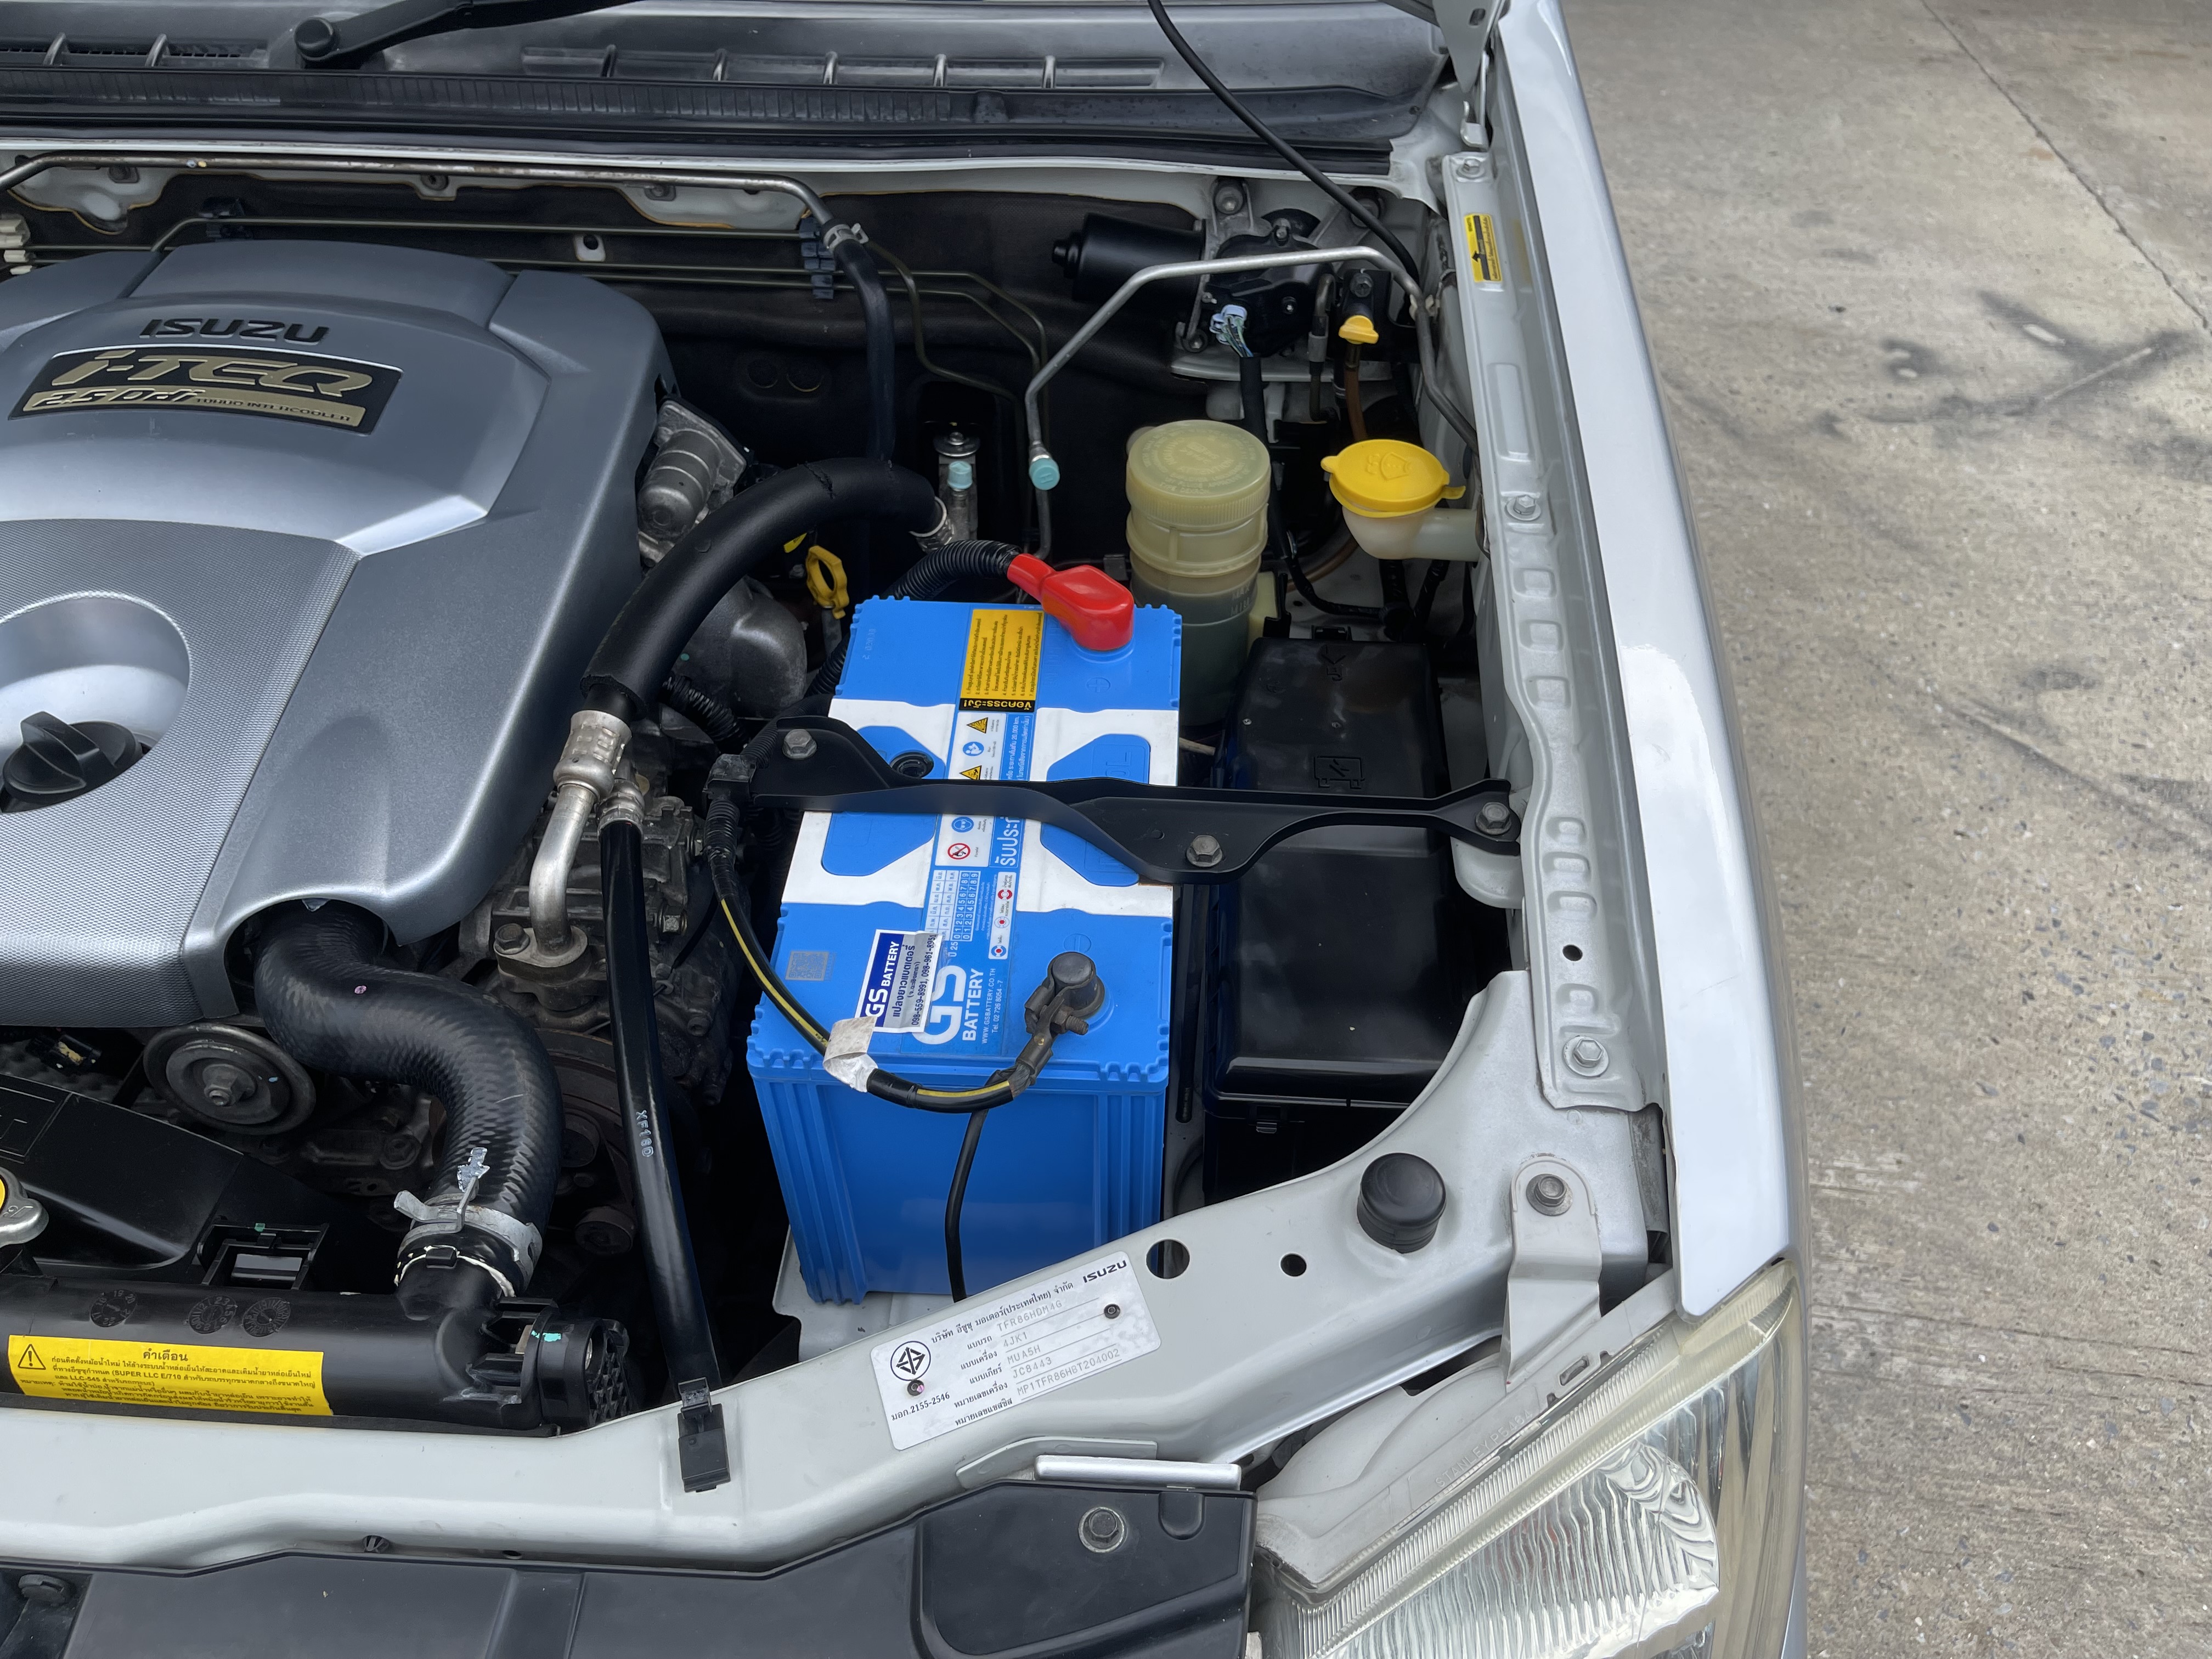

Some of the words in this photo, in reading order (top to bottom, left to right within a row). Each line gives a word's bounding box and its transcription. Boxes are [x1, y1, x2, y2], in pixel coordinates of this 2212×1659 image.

[139, 319, 329, 343] ISUZU
[247, 401, 351, 422] INTERCOOLER
[963, 699, 1032, 710] ข้อควรระวัง!
[950, 941, 958, 950] 25
[865, 989, 888, 1018] GS
[881, 941, 900, 986] BATTERY
[891, 945, 915, 1017] แปลงยาวแบตเตอรี่
[911, 979, 929, 1025] 098-559-8991,
[921, 934, 936, 977] 098-961-8951
[911, 965, 967, 1045] GS
[962, 968, 984, 1041] BATTERY
[982, 968, 996, 1044] WWW.GSBATTERY.CO.TH
[993, 1014, 1000, 1022] 02
[931, 1328, 953, 1344] บริษัท
[975, 1289, 1052, 1327] มอเตอร์(ประเทศไทย)
[1053, 1281, 1074, 1295] จำกัด
[1082, 1260, 1127, 1284] ISUZU
[966, 1335, 993, 1351] แบบรถ
[996, 1299, 1063, 1333] TFR86HDM4G
[143, 1348, 188, 1362] คำเตือน
[960, 1350, 998, 1370] แบบเครื่อง
[1002, 1331, 1028, 1348] 4JK1
[969, 1363, 1003, 1385] แบบเกียร์
[1007, 1344, 1041, 1365] MUA5H
[891, 1391, 950, 1421] มอก.2155-2546
[953, 1381, 1008, 1408] หมายเลขเครื่อง
[1012, 1357, 1052, 1380] JC8443
[1435, 1440, 1490, 1488] STANLEY
[1489, 1409, 1533, 1444] P5464
